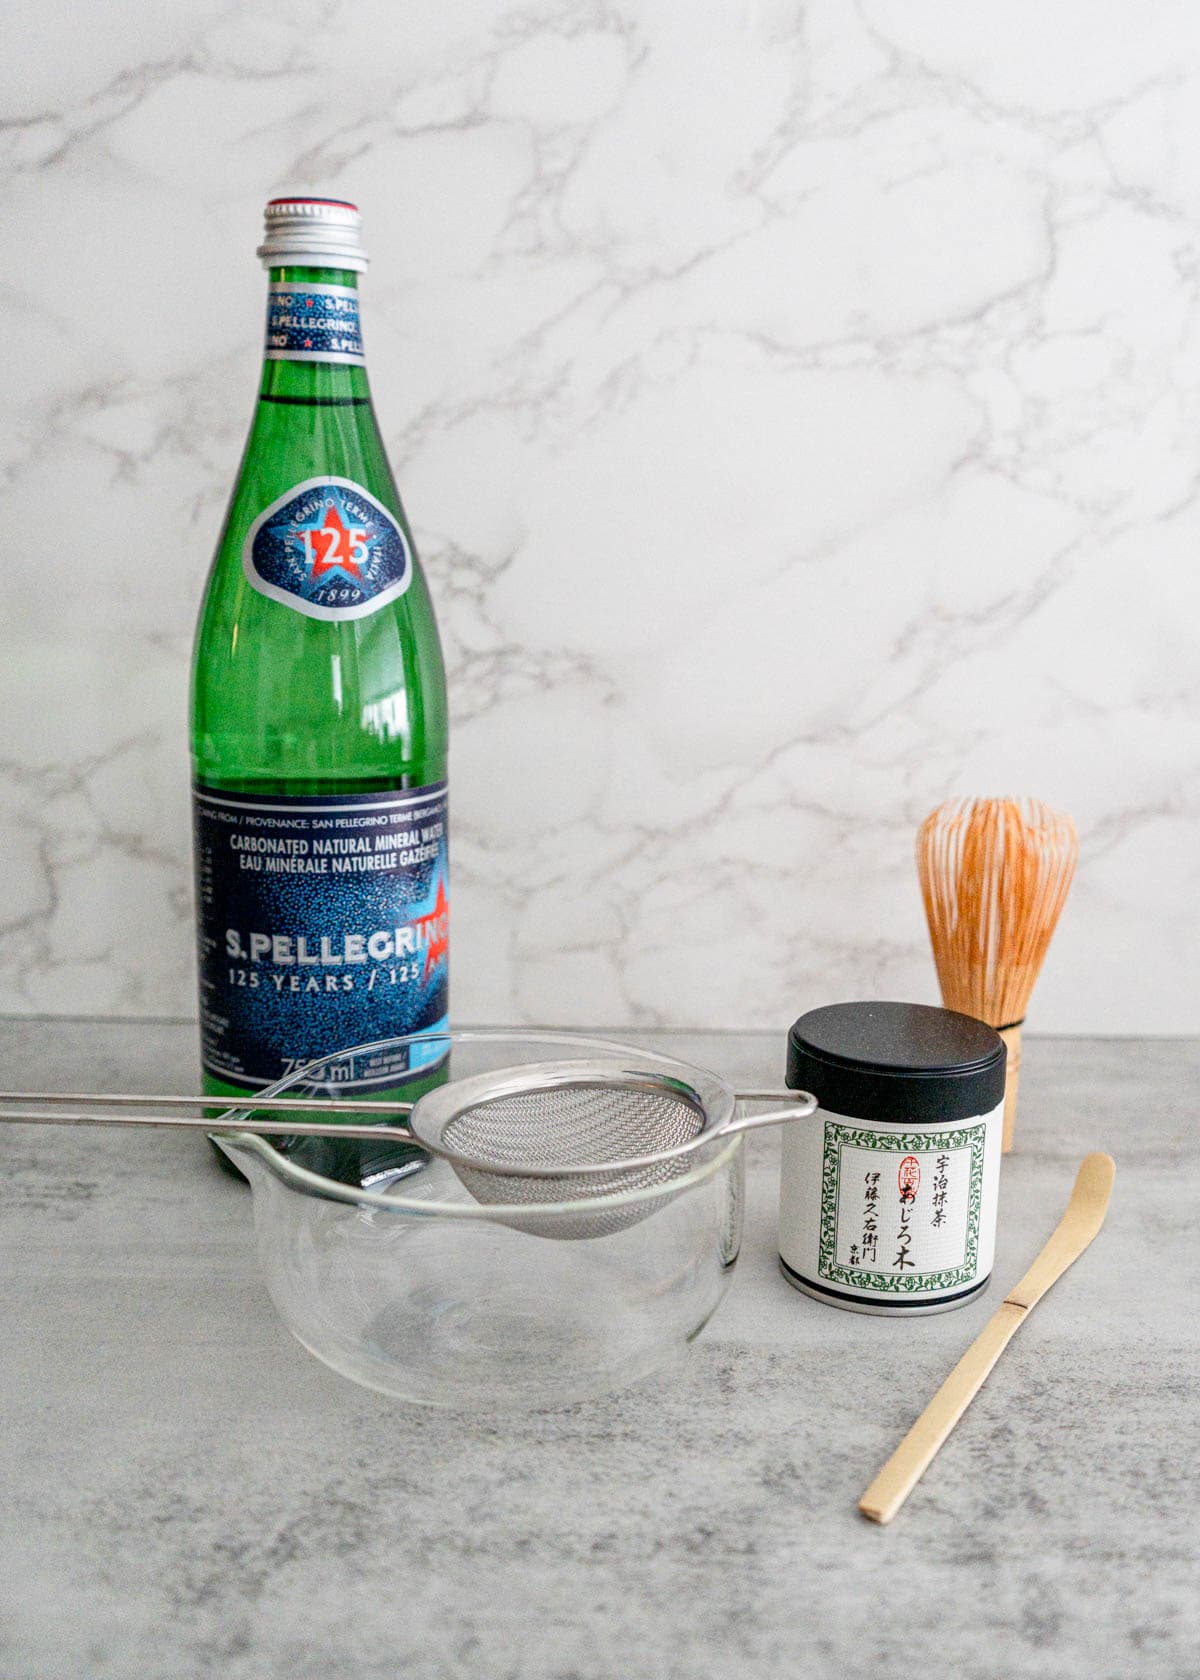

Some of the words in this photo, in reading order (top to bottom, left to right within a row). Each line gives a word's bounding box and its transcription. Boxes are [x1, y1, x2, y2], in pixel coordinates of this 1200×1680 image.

[339, 499, 375, 529] TERME
[300, 527, 369, 565] 125
[317, 588, 361, 602] 1899
[312, 818, 333, 829] SAN
[335, 814, 389, 829] PELLEGRINO
[230, 834, 309, 855] CARBONATED
[312, 836, 372, 855] NATURAL
[374, 829, 420, 851] MINERAL
[239, 854, 262, 870] EAU
[265, 853, 328, 873] MINÉRALE
[331, 852, 398, 873] NATURELLE
[229, 968, 260, 988] 125
[272, 976, 354, 992] YEARS
[389, 963, 419, 985] 125
[330, 1056, 354, 1081] ml
[930, 1155, 950, 1228] 宇治抹茶
[862, 1172, 881, 1263] 伊藤久右衛門
